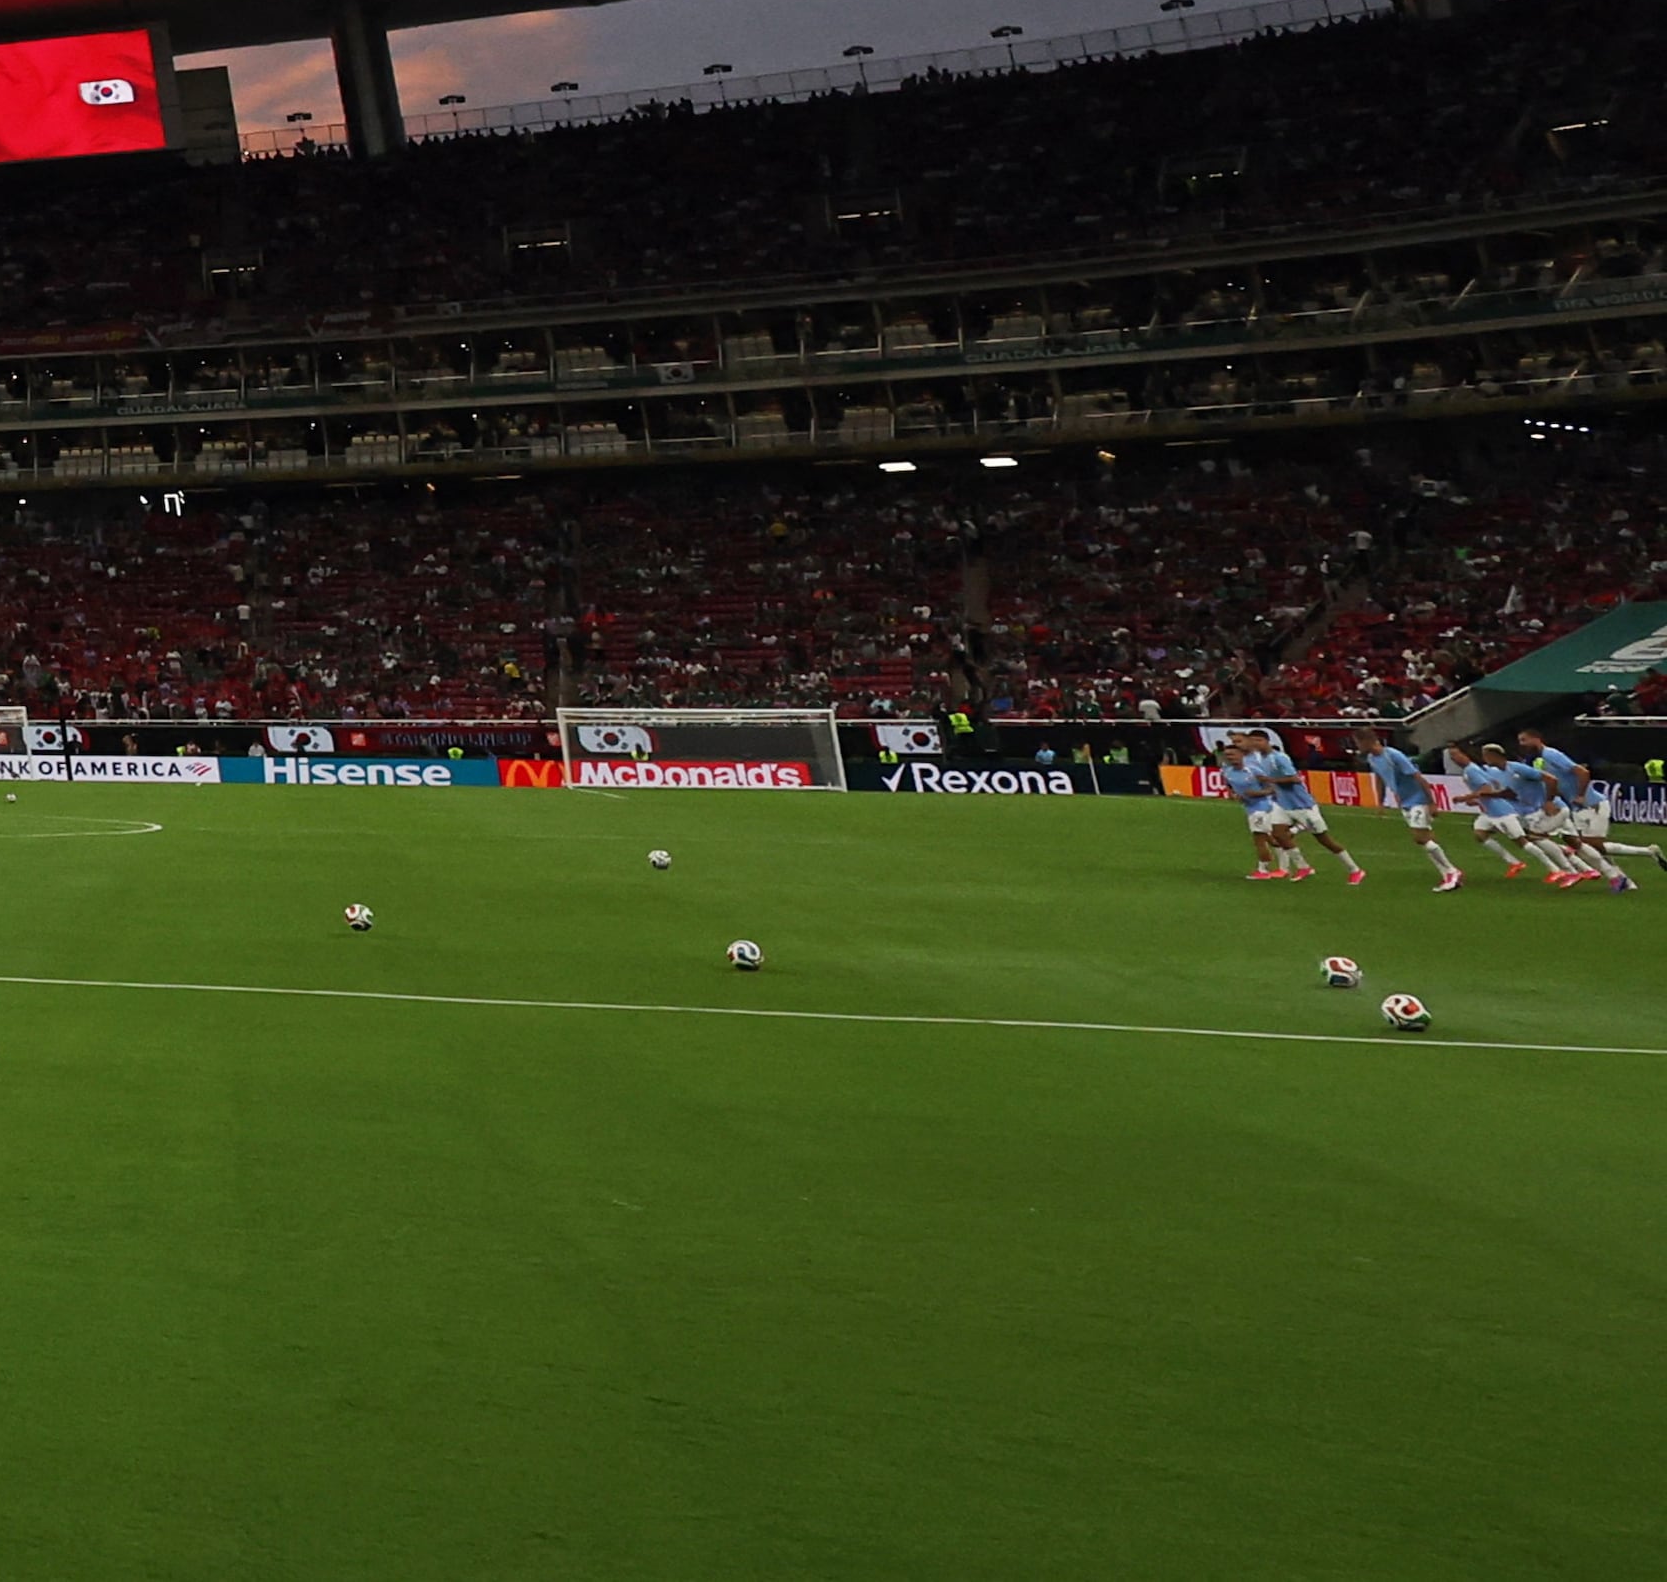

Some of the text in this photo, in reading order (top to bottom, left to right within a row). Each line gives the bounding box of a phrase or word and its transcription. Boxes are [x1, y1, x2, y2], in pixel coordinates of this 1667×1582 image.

[117, 402, 247, 415] GUADALAJARA
[38, 761, 67, 775] OF
[74, 761, 182, 777] AMERICA
[265, 757, 451, 786] Hisense
[579, 761, 803, 787] McDonald's
[910, 763, 1074, 794] Rexona
